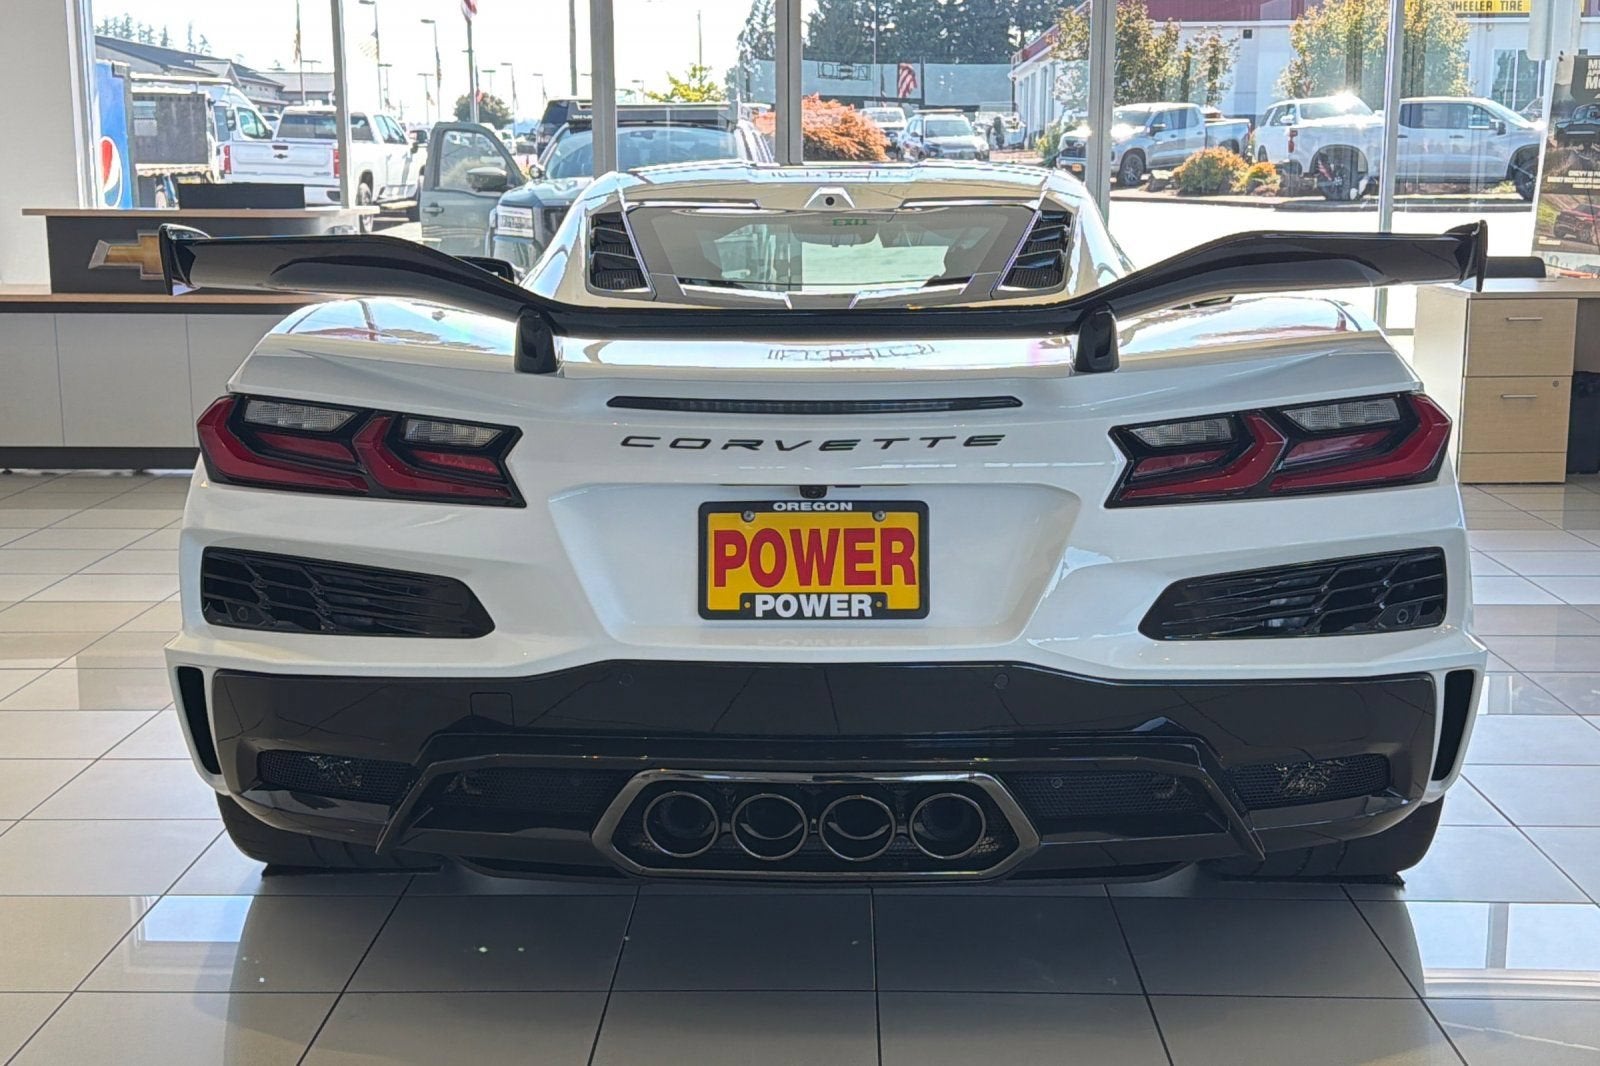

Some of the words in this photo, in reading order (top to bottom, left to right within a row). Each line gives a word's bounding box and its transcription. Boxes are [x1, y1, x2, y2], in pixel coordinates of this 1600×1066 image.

[1500, 0, 1522, 11] TIRE
[620, 433, 1007, 452] CORVETTE
[772, 501, 853, 512] OREGON
[713, 527, 917, 588] POWER
[755, 593, 873, 618] POWER
